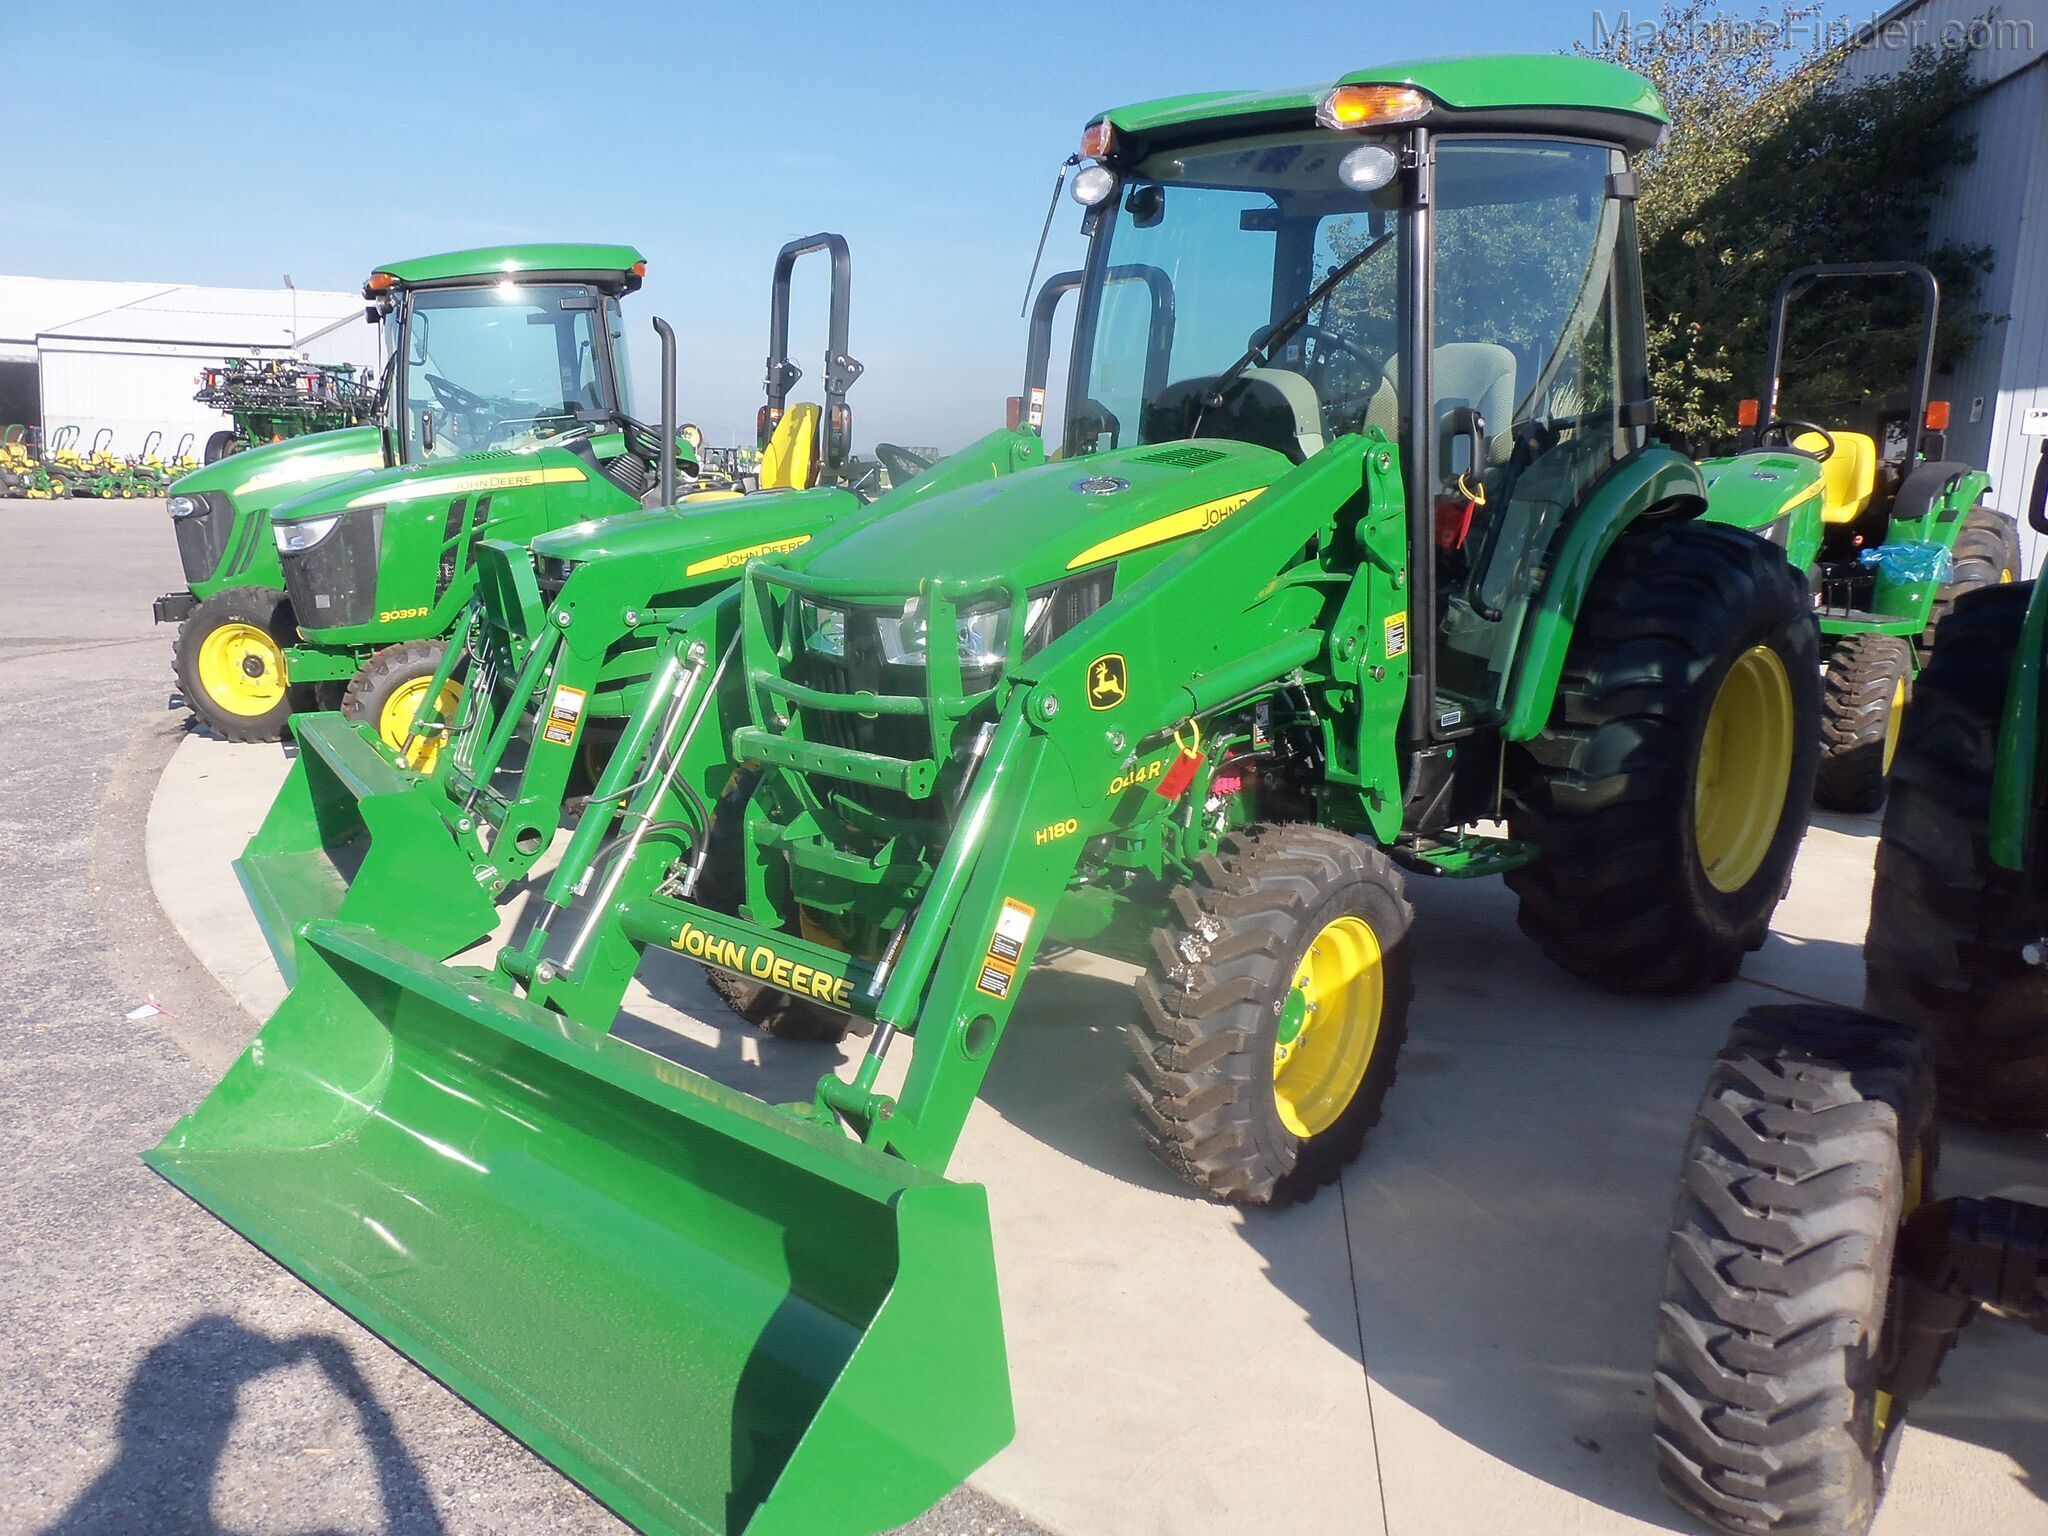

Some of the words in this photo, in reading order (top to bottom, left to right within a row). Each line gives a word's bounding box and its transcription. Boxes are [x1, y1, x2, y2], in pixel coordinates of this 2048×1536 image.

[455, 480, 488, 491] JOHN
[490, 475, 532, 487] DEERE
[1035, 818, 1078, 846] H180
[670, 921, 748, 972] JOHN
[750, 945, 856, 1008] DEERE
